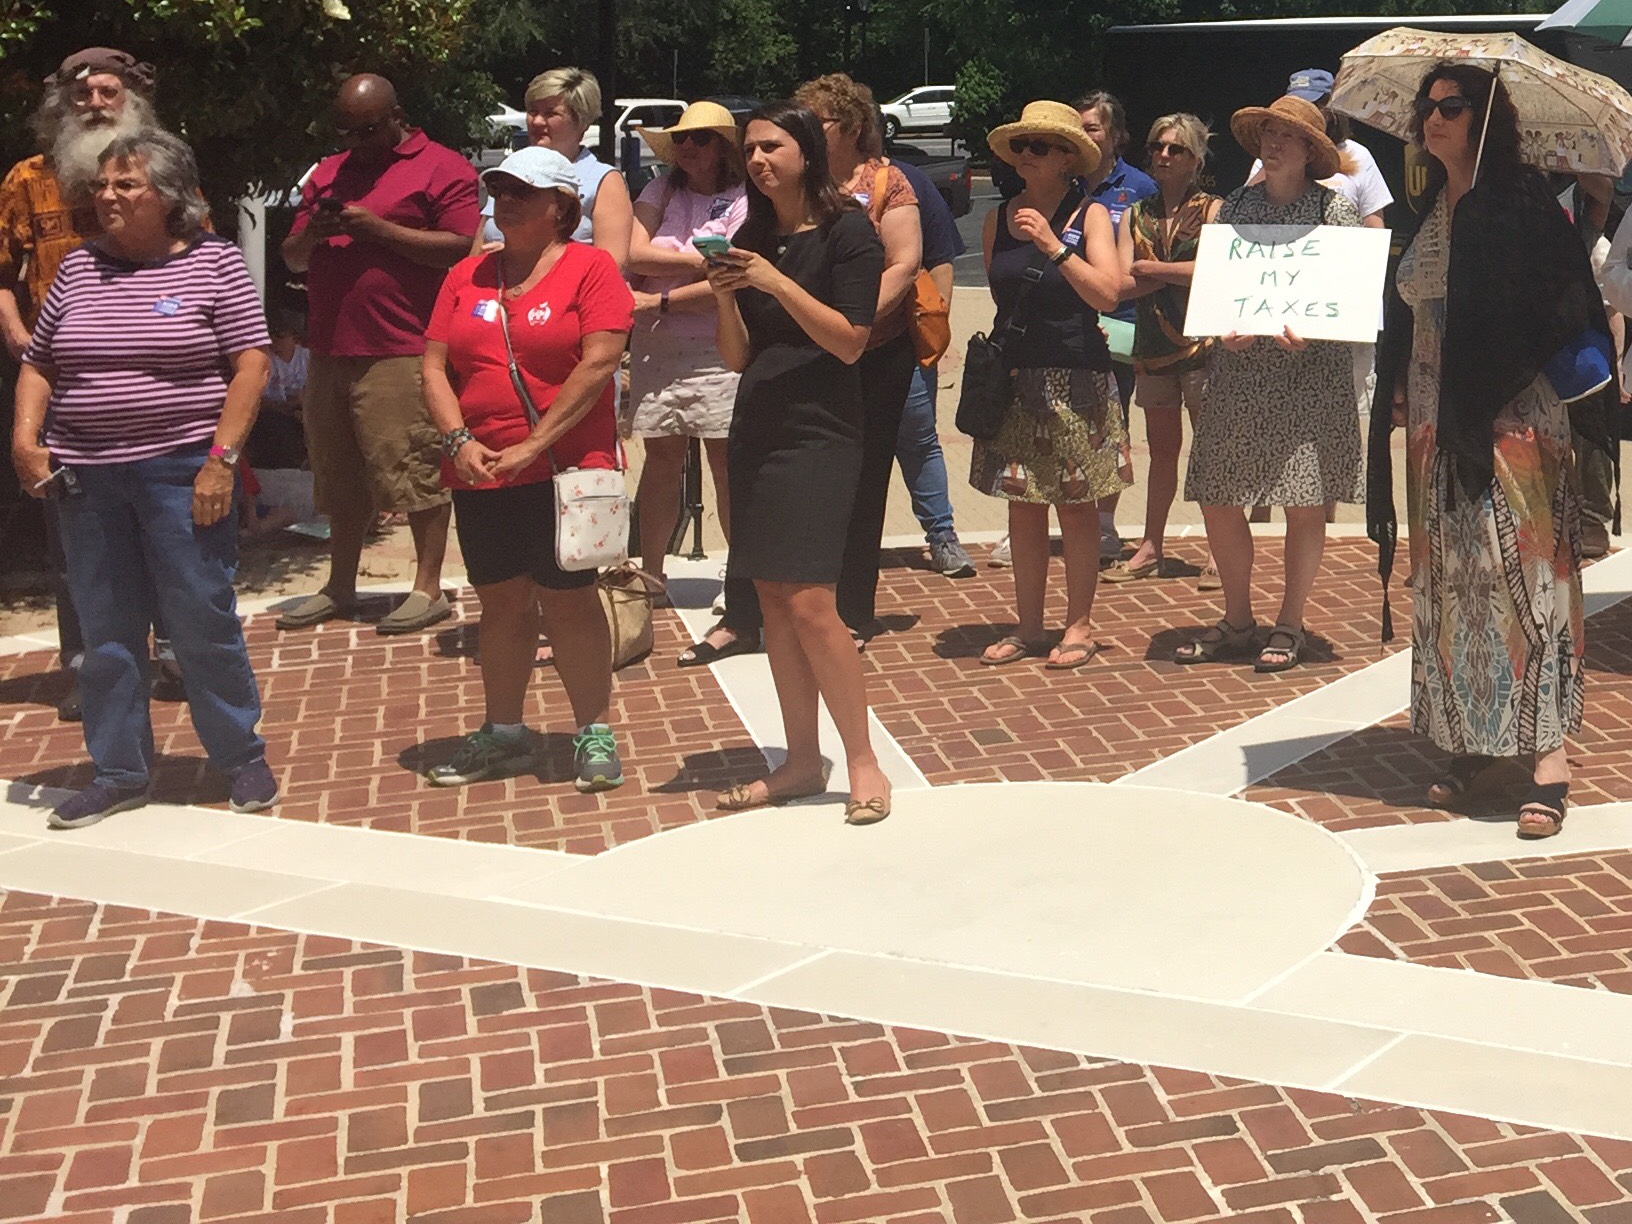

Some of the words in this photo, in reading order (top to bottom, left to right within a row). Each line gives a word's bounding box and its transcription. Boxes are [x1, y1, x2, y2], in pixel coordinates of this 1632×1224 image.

[1229, 237, 1320, 260] RAISE
[1260, 269, 1301, 287] MY
[1234, 295, 1339, 318] TAXES
